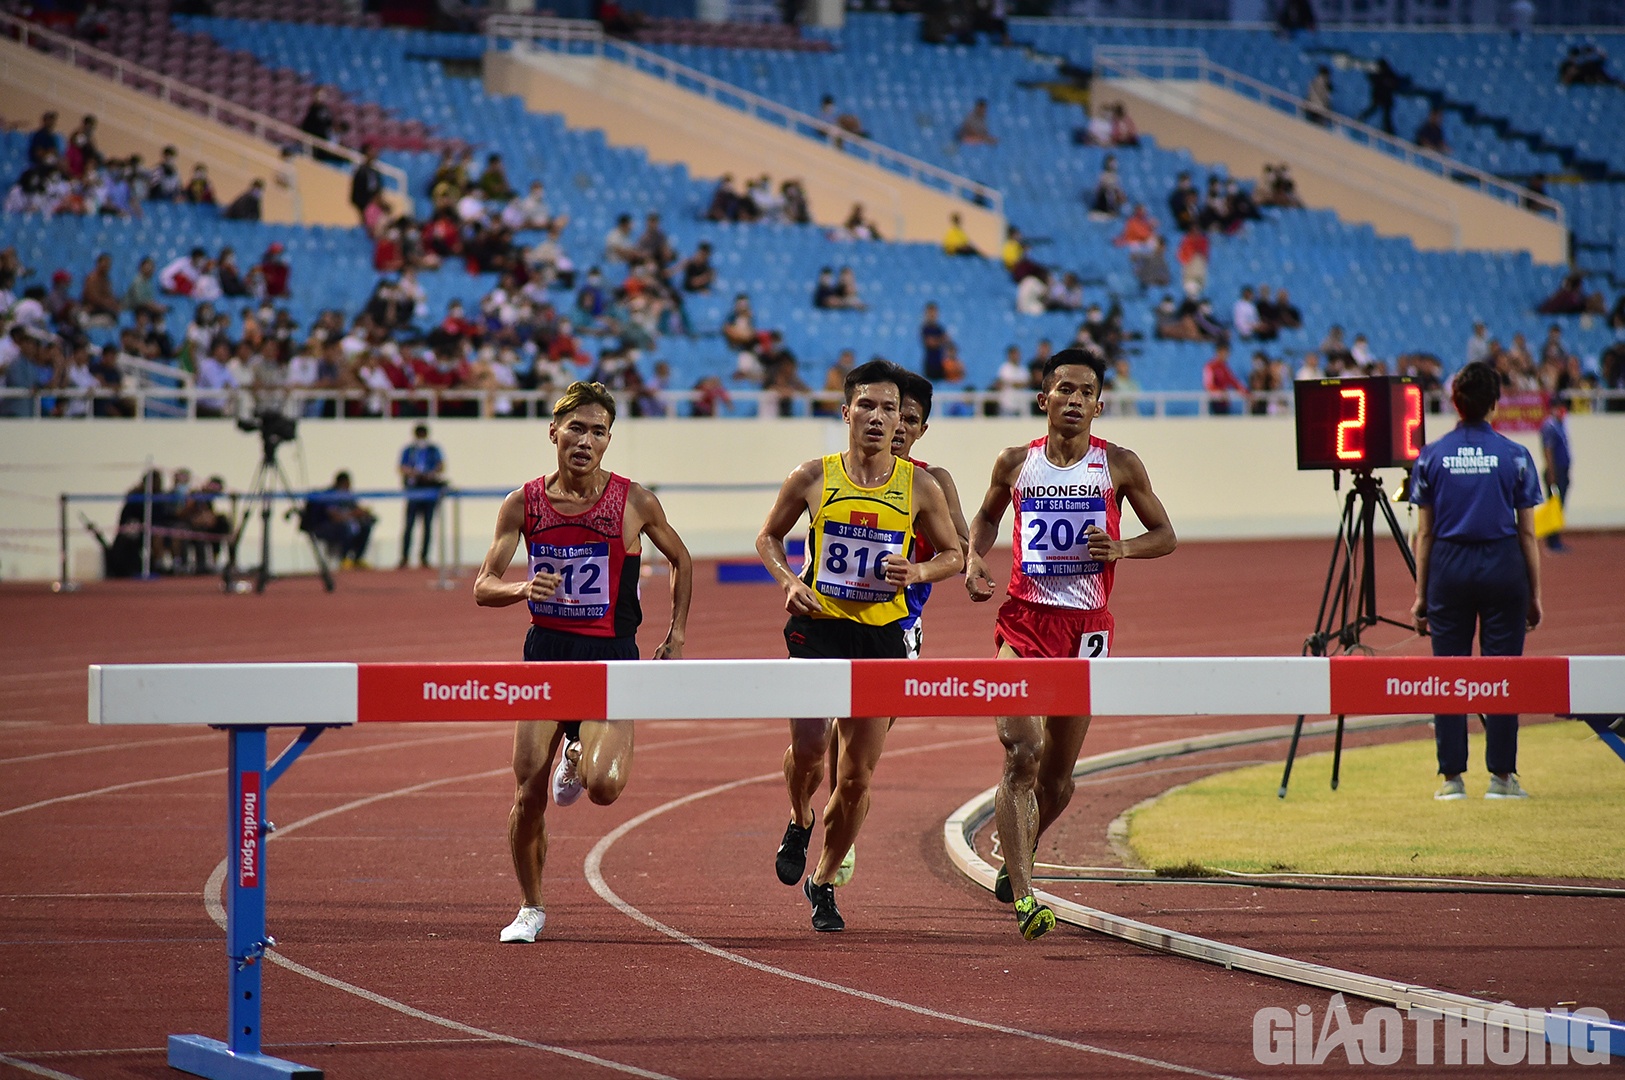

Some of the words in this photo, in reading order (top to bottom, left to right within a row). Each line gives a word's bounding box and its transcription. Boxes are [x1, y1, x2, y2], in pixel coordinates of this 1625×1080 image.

[1336, 389, 1365, 460] 2
[1405, 386, 1421, 458] 2
[1458, 446, 1475, 456] FOR
[1476, 446, 1483, 456] A
[1442, 455, 1498, 468] STRONGER
[1022, 484, 1102, 498] INDONESIA
[1050, 500, 1064, 510] SEA
[1065, 500, 1090, 510] Games
[852, 527, 867, 537] SEA
[868, 530, 892, 542] Games
[554, 548, 567, 558] SEA
[569, 547, 592, 557] Games
[1027, 564, 1046, 574] HANOI
[1052, 564, 1082, 574] VIETNAM
[1084, 562, 1099, 572] 2022
[820, 584, 841, 596] HANOI
[846, 589, 874, 601] VIETNAM
[534, 603, 554, 614] HANOI
[558, 607, 585, 616] VIETNAM
[587, 606, 604, 616] 2022
[1087, 634, 1104, 658] 2
[493, 682, 552, 705] Sport
[972, 679, 1028, 702] Sport
[1454, 678, 1510, 701] Sport
[241, 839, 256, 877] Sport
